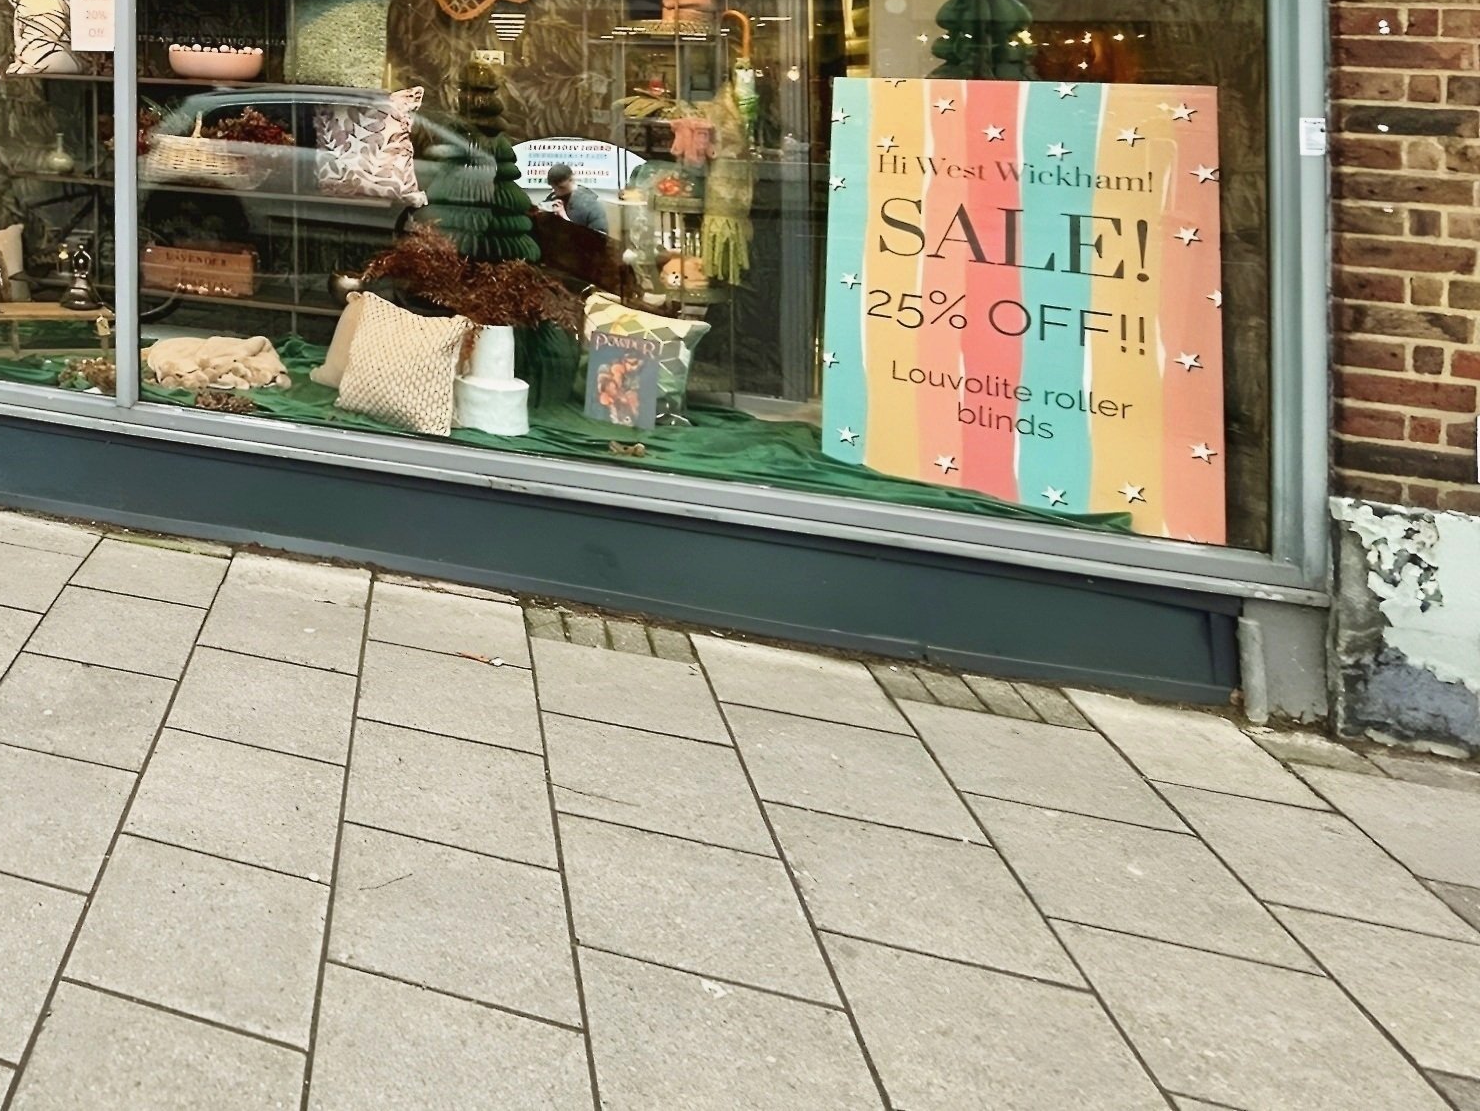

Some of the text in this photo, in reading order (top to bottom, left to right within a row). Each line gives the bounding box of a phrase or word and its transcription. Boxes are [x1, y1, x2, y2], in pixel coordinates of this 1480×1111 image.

[877, 154, 1154, 194] Hi West Wickham!
[879, 197, 1152, 284] SALE!
[867, 289, 1147, 357] 25% OFF!!
[891, 360, 1134, 421] Louvolite roller
[958, 401, 1055, 440] blinds
